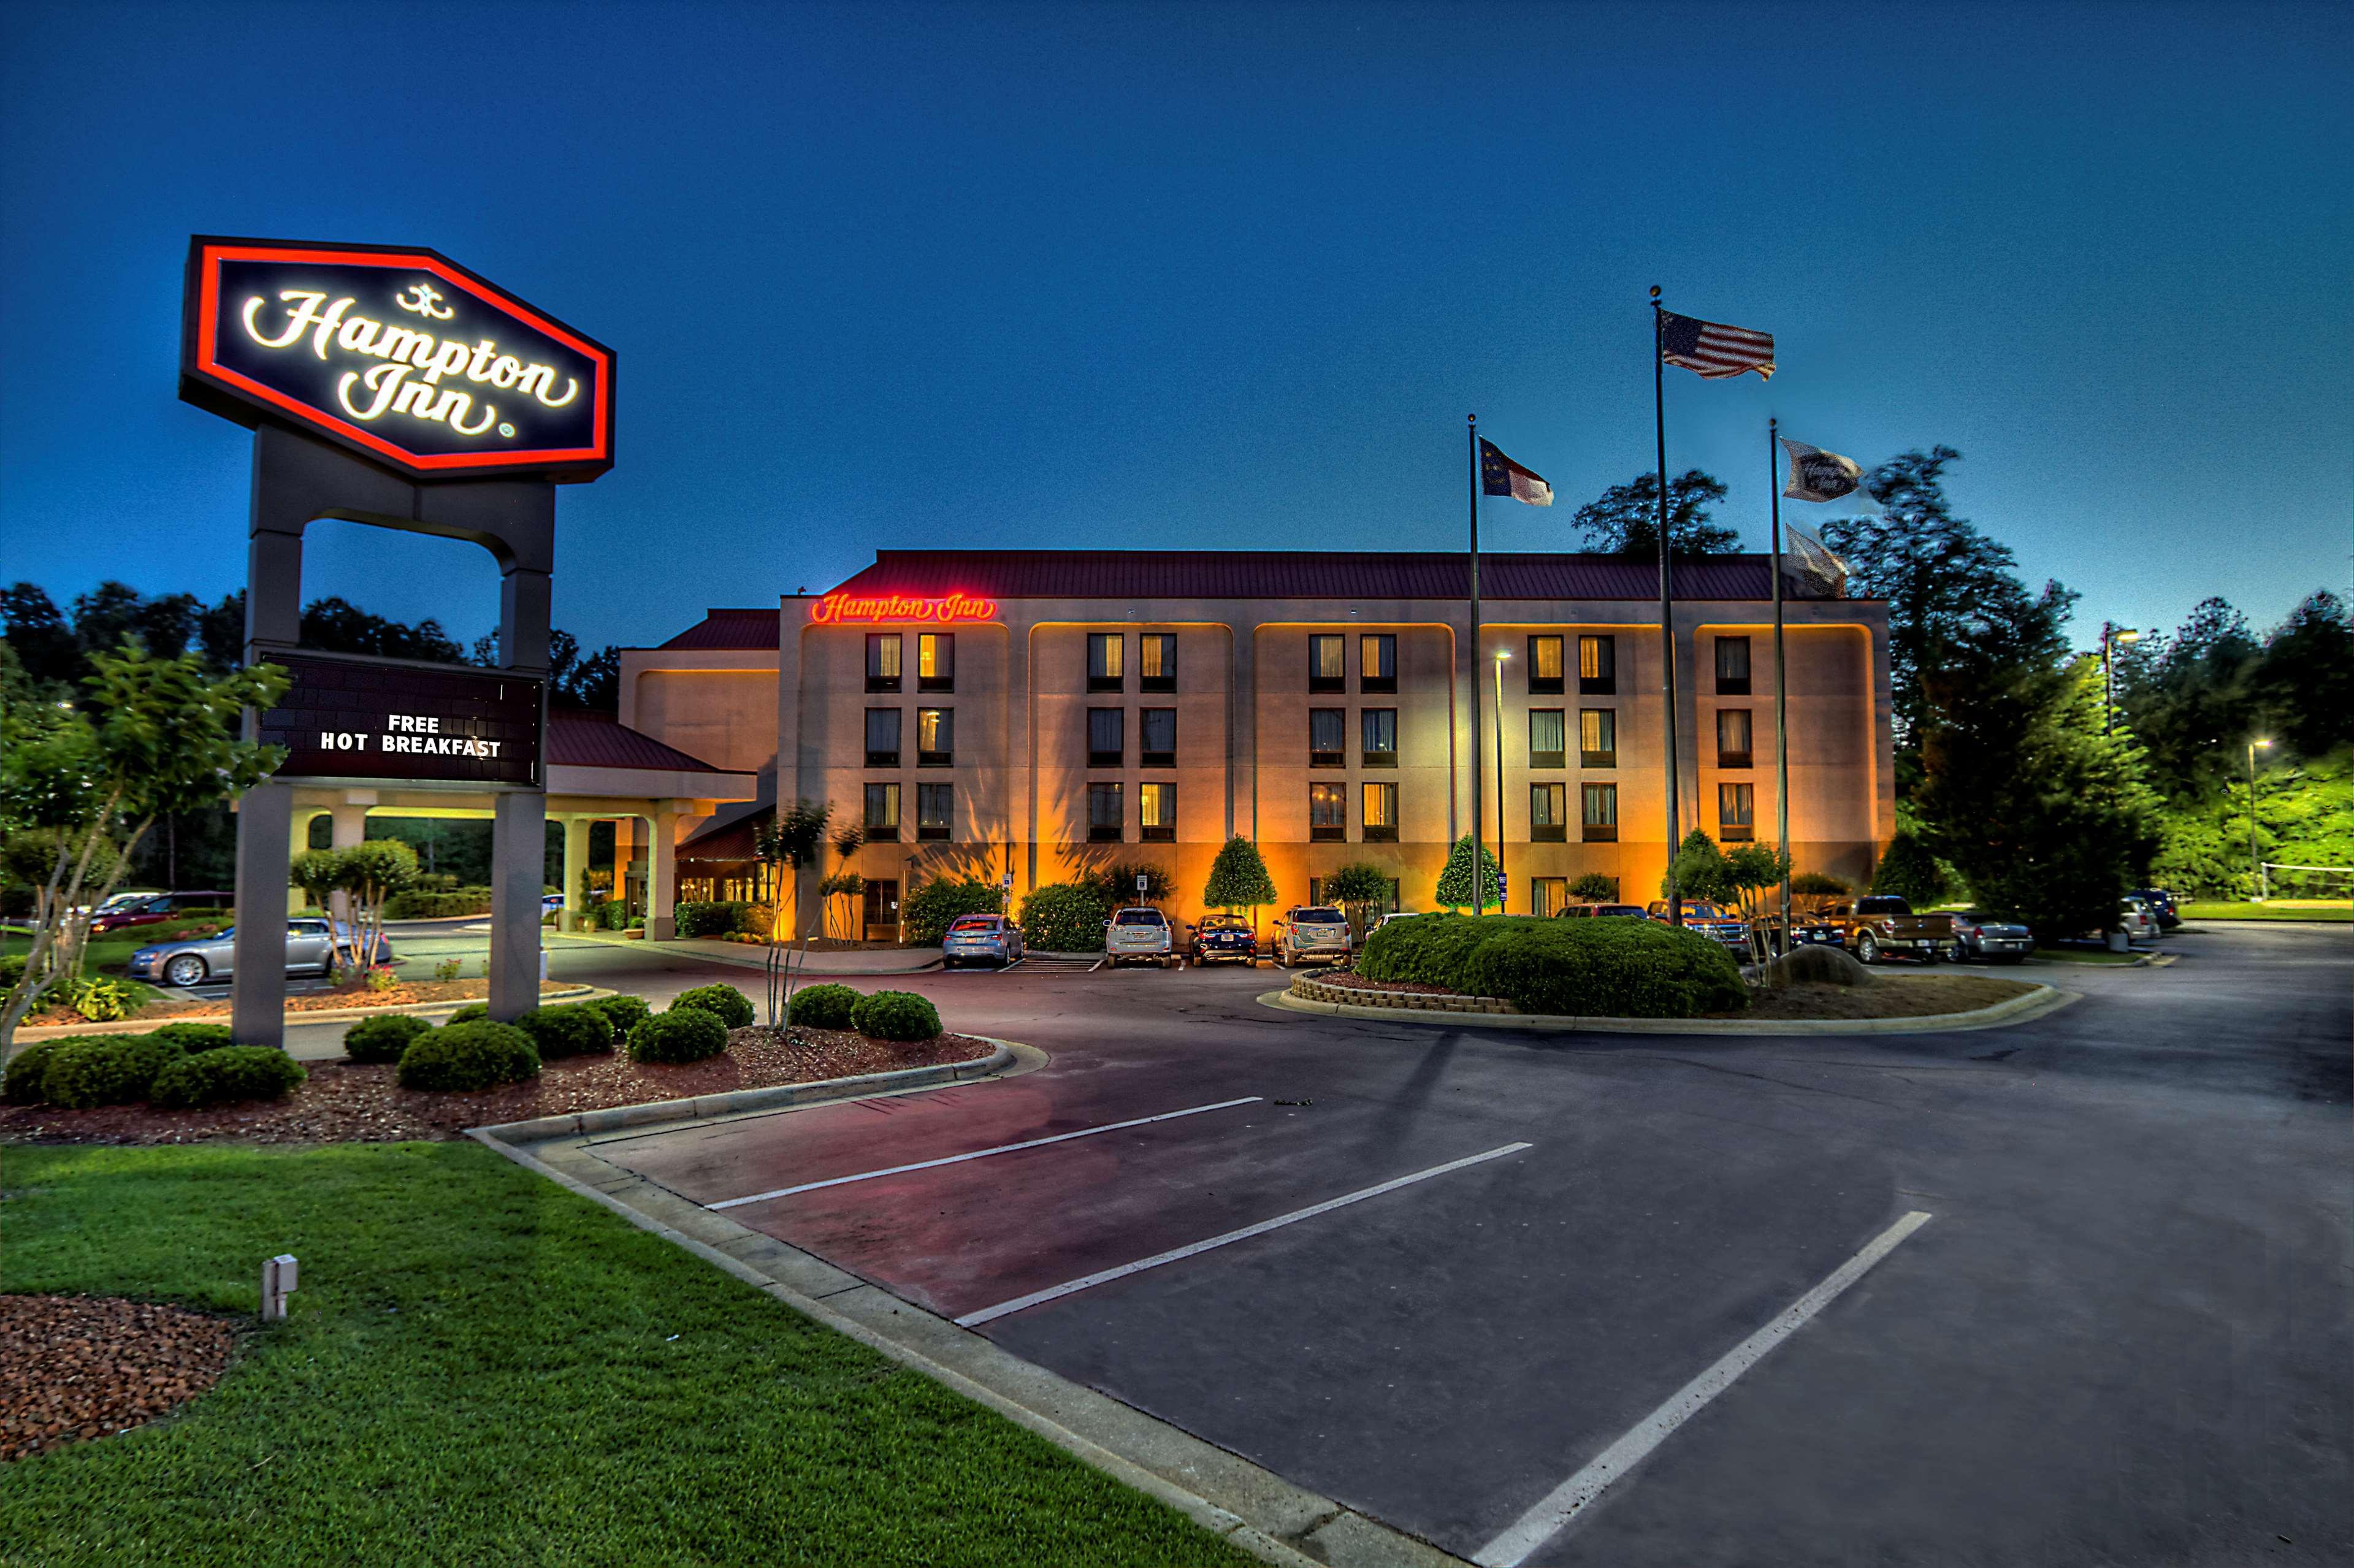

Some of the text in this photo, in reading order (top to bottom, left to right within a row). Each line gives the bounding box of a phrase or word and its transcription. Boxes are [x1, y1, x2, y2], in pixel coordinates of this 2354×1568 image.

[243, 290, 578, 407] Hampton
[338, 364, 495, 435] Inn
[812, 593, 995, 622] Hampton Inn
[388, 714, 439, 733] FREE
[321, 732, 501, 757] HOT BREAKFAST
